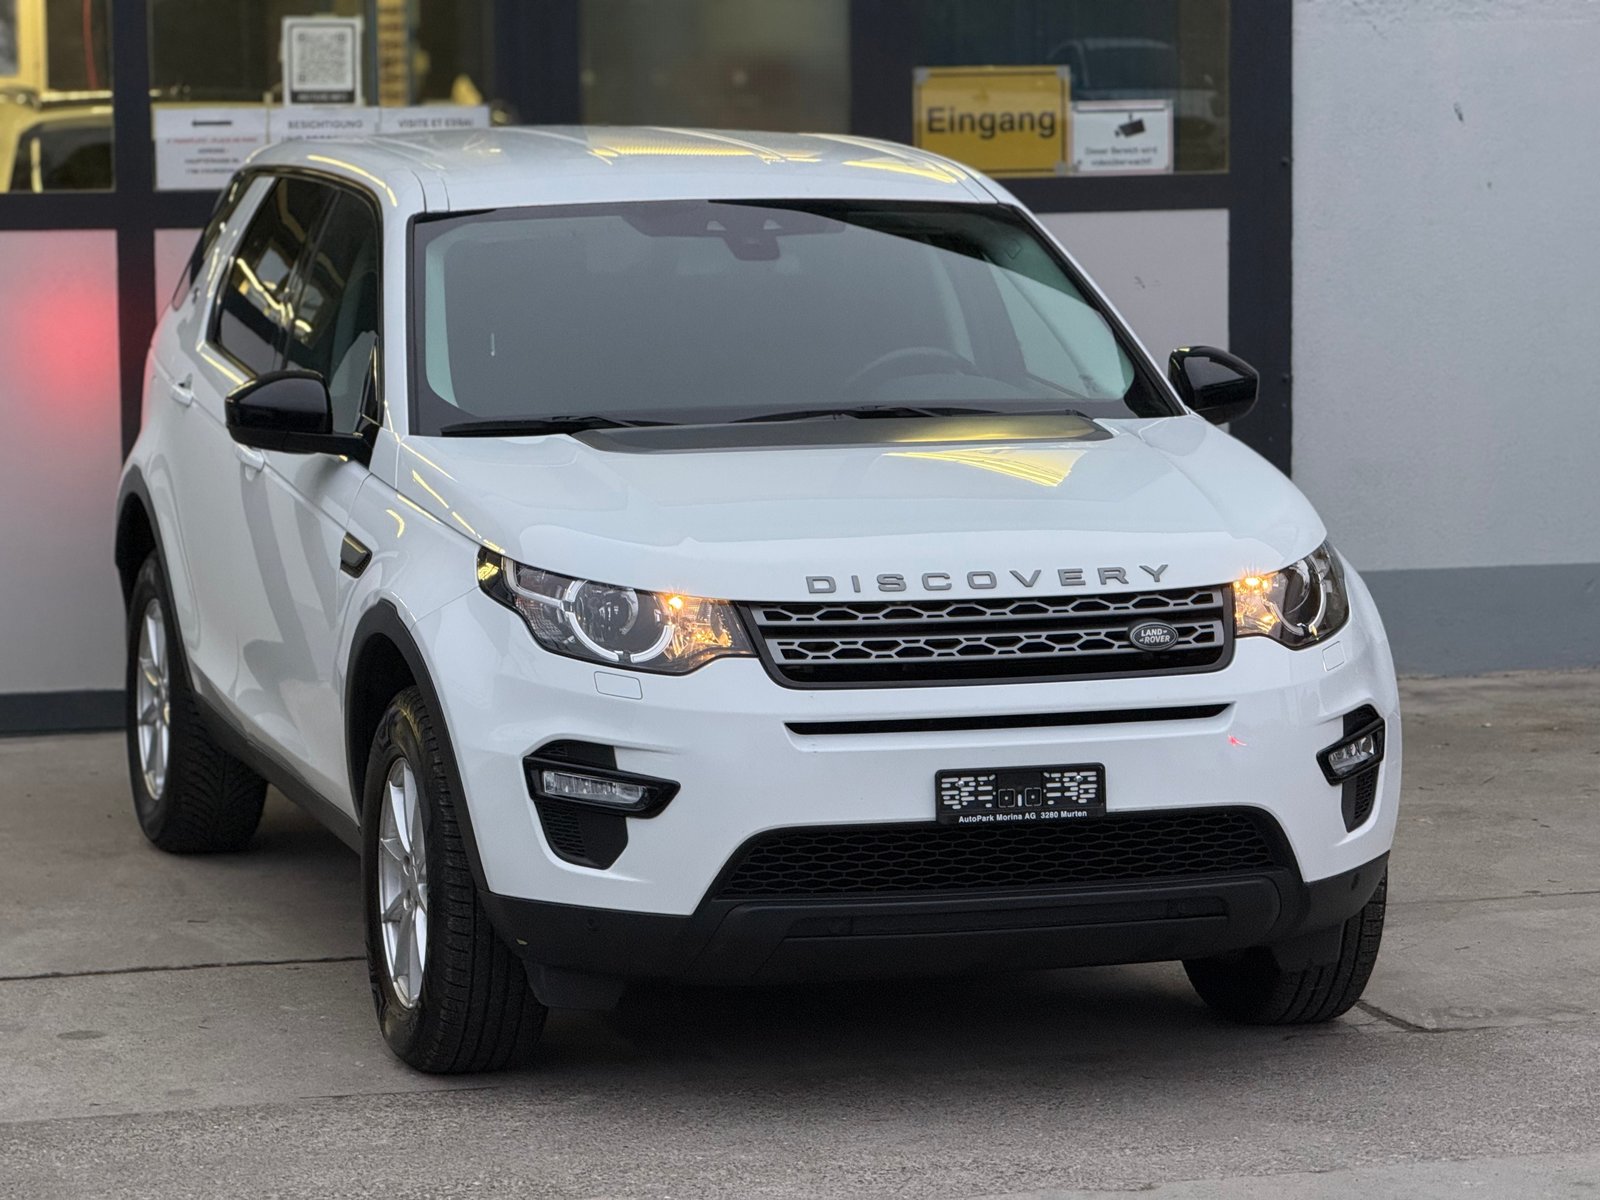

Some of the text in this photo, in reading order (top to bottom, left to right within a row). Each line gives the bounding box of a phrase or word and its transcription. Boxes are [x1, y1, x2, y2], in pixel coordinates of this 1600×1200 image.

[927, 107, 1057, 139] Eingang
[805, 564, 1169, 594] DISCOVERY
[958, 810, 1087, 823] AutoPark Morina AG 3280 Murten
